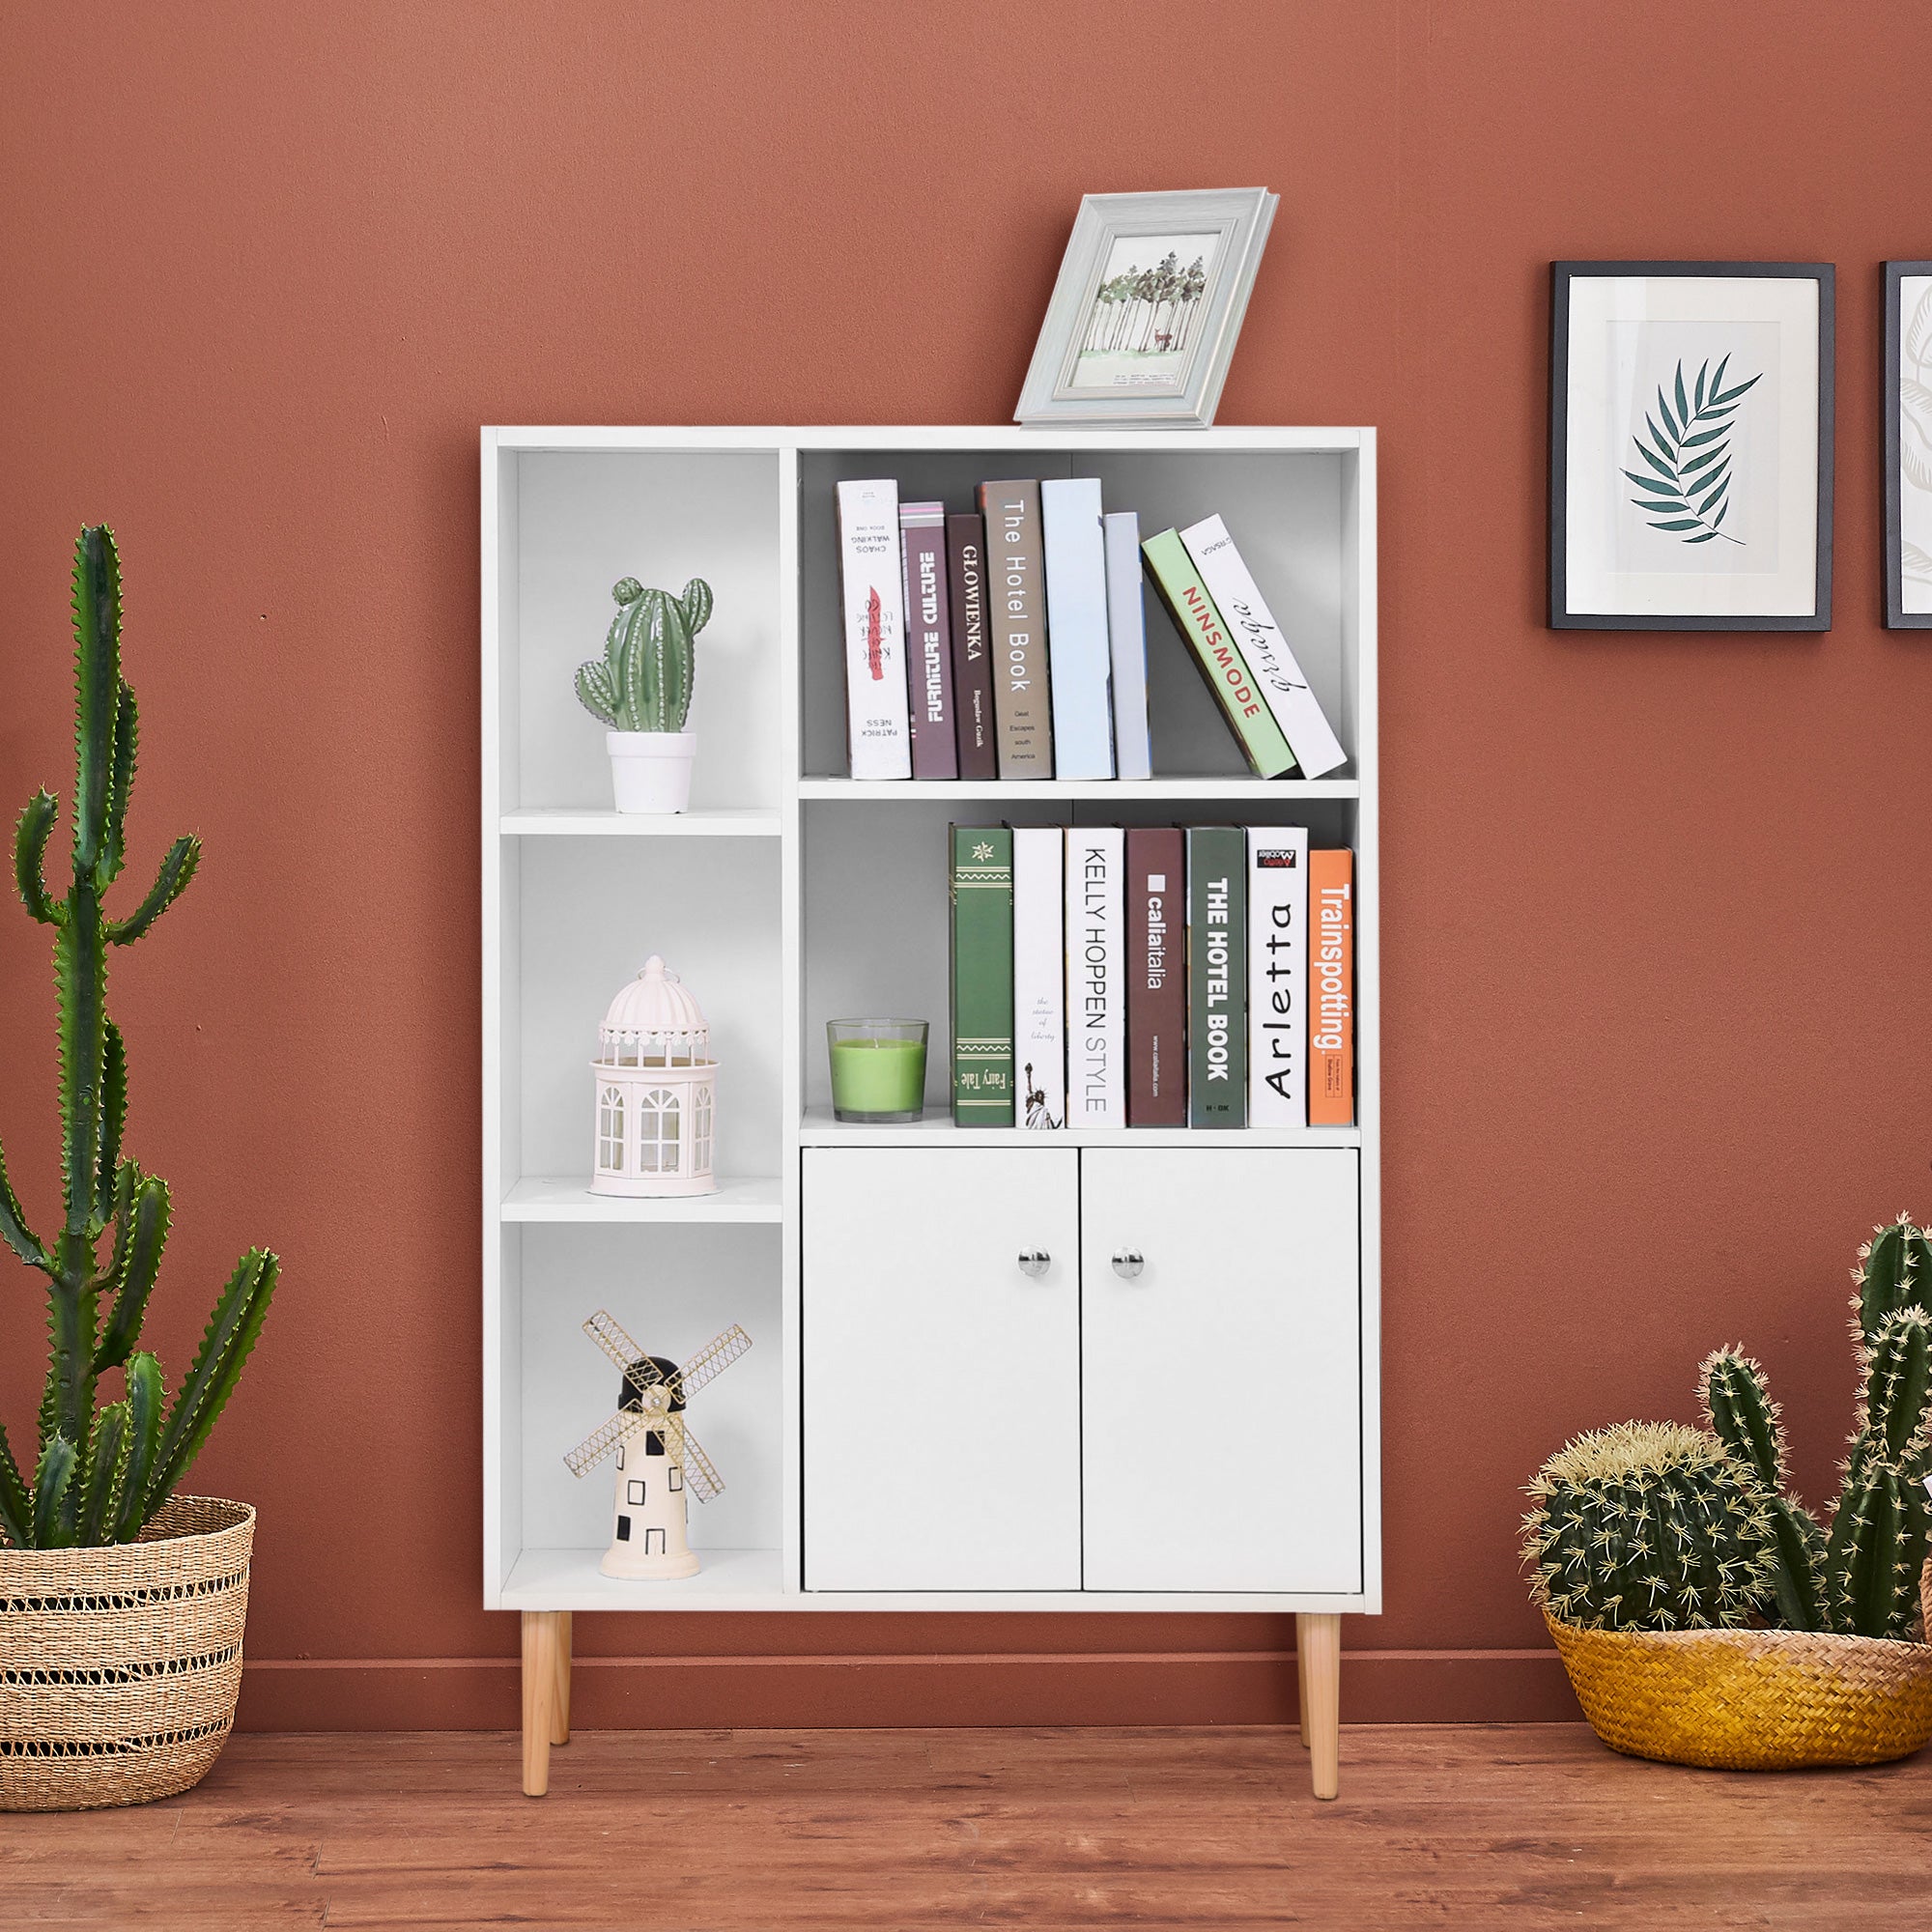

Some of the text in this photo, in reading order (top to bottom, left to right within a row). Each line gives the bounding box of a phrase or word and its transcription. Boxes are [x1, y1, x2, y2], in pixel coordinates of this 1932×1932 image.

[851, 535, 891, 544] WALKING
[962, 545, 982, 662] GŁOWIENKA
[1005, 499, 1031, 692] The Hotel Book
[920, 552, 943, 723] FURNITURE CULTURE
[1181, 585, 1261, 719] NINSMODE
[861, 728, 898, 737] PATRICK
[867, 719, 893, 727] NESS
[1085, 848, 1106, 1112] KELLY HOPPEN STYLE
[1207, 877, 1229, 1081] THE HOTEL BOOK
[1263, 903, 1292, 1099] Arletta
[961, 1068, 1007, 1090] Fairy Tale
